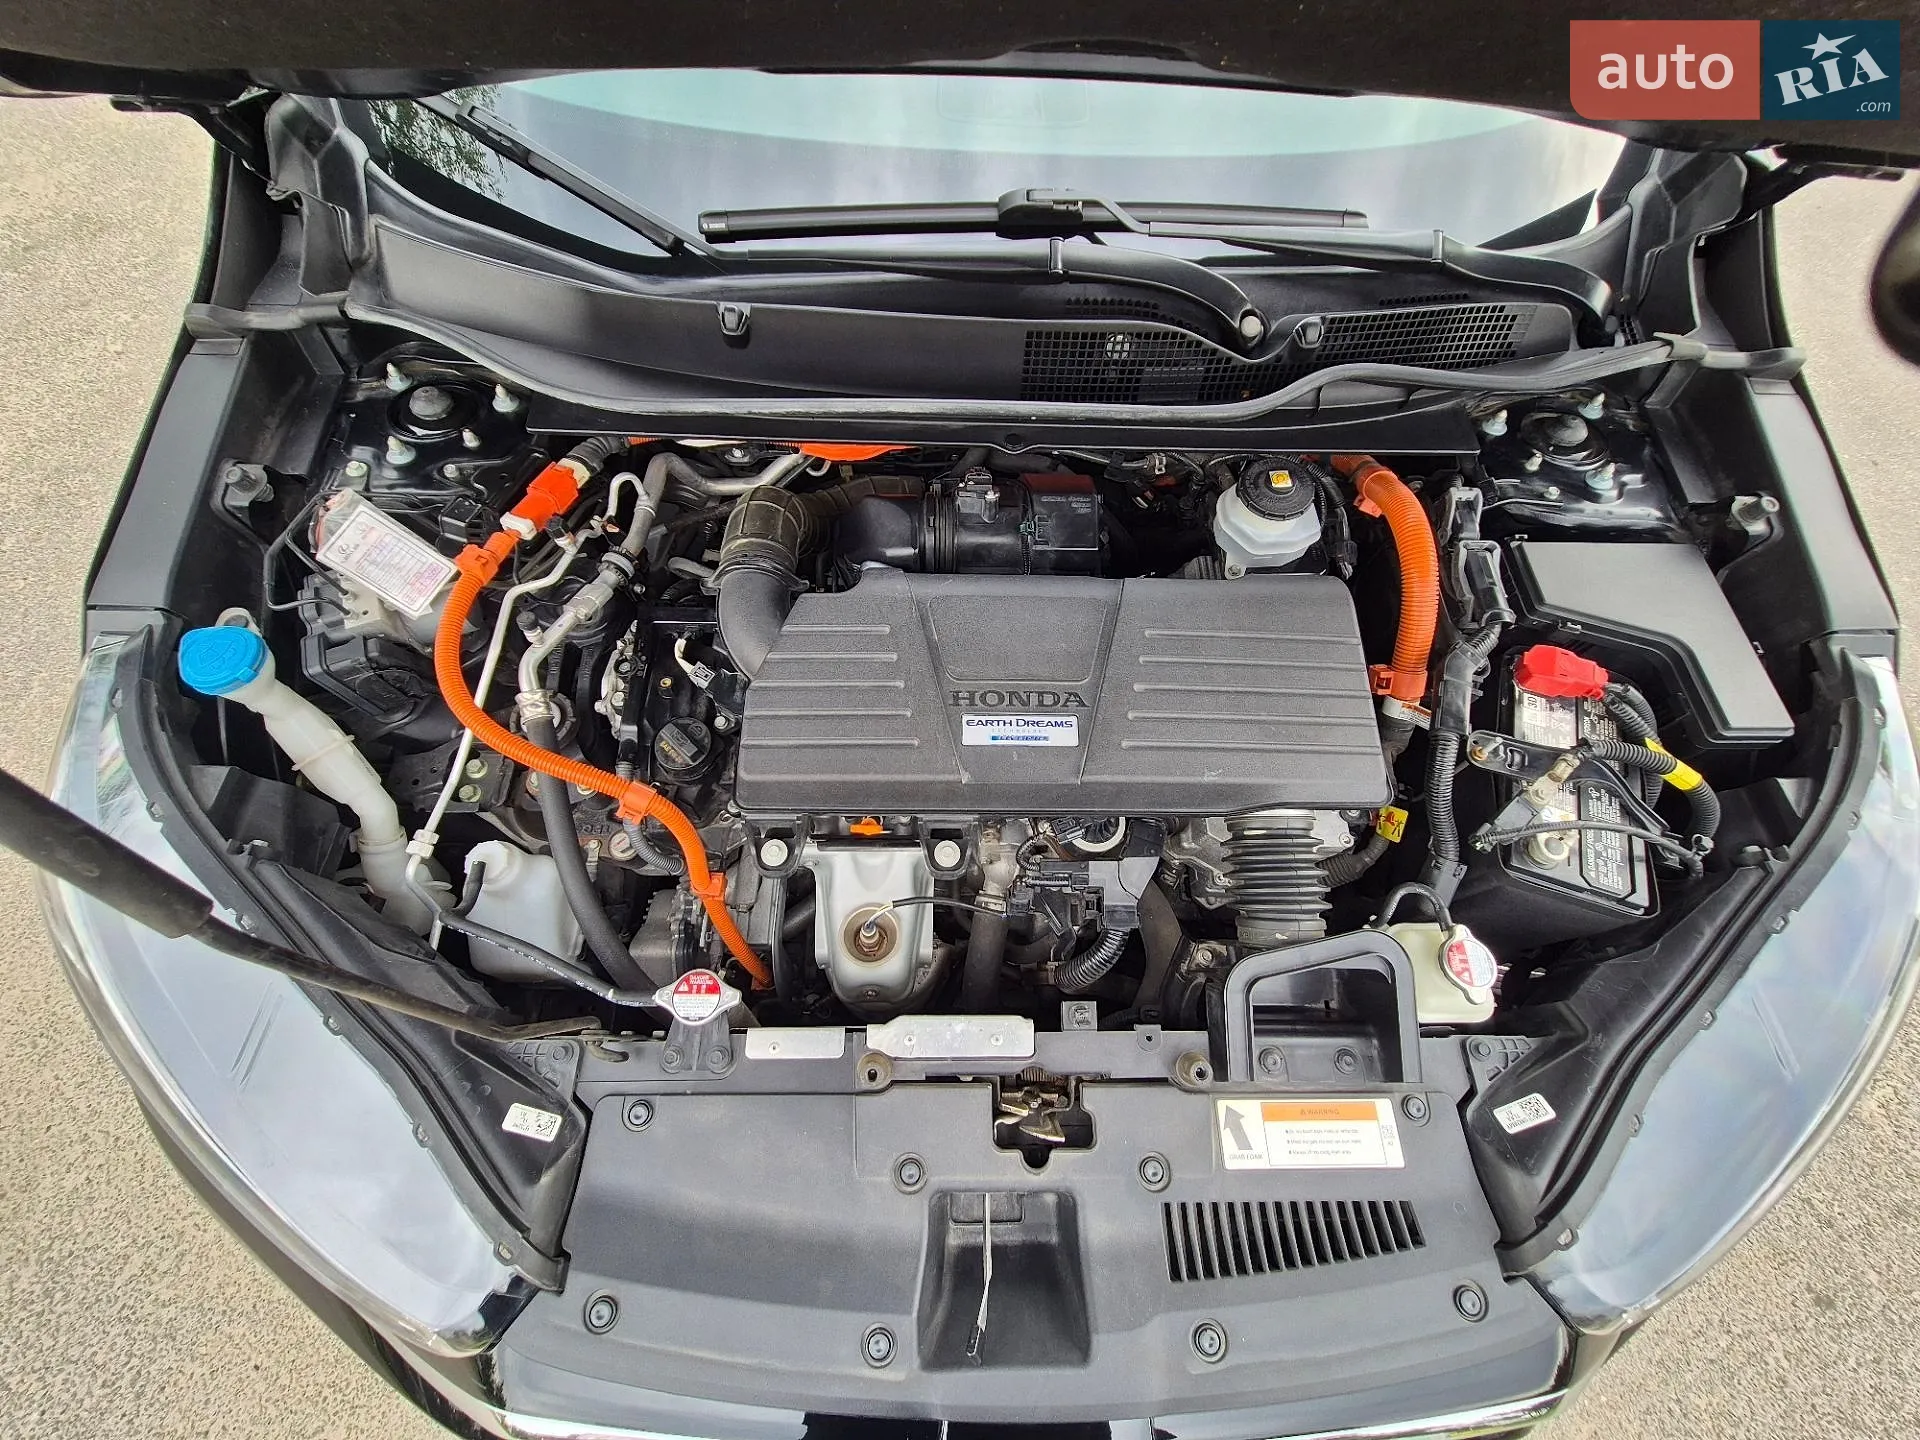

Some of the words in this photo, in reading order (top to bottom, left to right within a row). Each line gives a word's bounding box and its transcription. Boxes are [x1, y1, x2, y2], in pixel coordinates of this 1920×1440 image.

[948, 690, 1090, 708] HONDA
[966, 719, 1012, 728] EARTH
[1016, 718, 1073, 728] DREAMS
